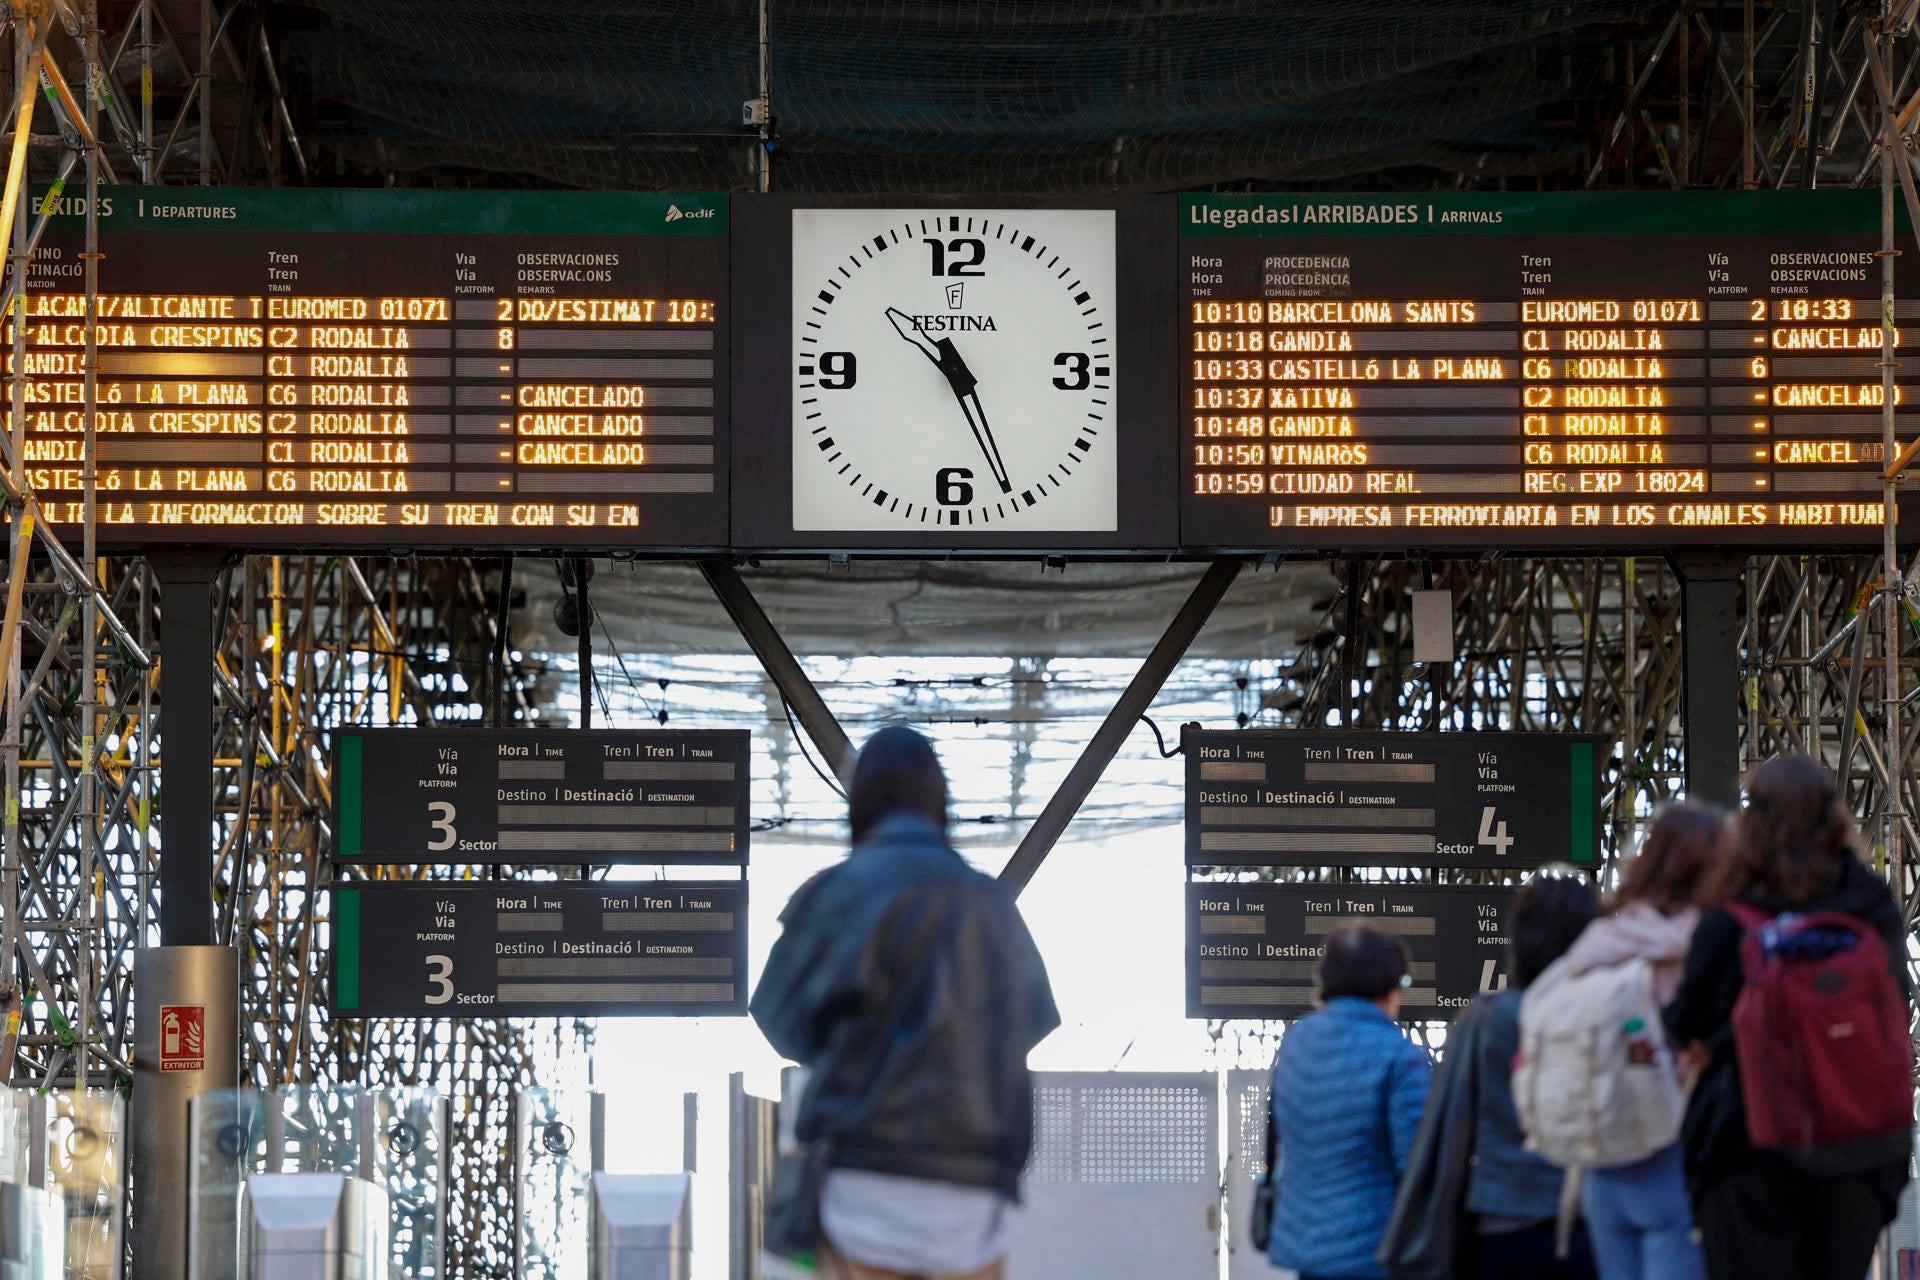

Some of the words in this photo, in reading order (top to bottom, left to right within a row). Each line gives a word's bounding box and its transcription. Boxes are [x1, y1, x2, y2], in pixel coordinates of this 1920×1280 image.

[32, 197, 113, 216] EXIDS
[153, 206, 236, 218] DEPARTURES
[685, 208, 715, 219] adif
[1192, 205, 1289, 228] Llegadas
[1303, 205, 1417, 223] ARRIBADES
[1442, 212, 1501, 222] ARRIVALS
[268, 252, 297, 263] Tren
[518, 254, 618, 265] OBSERVACIONES
[923, 239, 985, 276] 12
[1192, 256, 1222, 267] Hora
[1266, 257, 1349, 268] PROCEDENCIA
[1522, 256, 1551, 266] Tren
[1709, 253, 1728, 265] Vía
[1771, 253, 1874, 264] OBSERVACIONES
[6, 263, 82, 276] DSTINACIÓ
[268, 268, 297, 279] Tren
[456, 269, 475, 280] Via
[1771, 270, 1865, 281] OBSERVACIONS
[1192, 272, 1222, 283] Hora
[1522, 272, 1551, 282] Tren
[270, 299, 366, 319] EUROMED
[381, 300, 448, 320] 01071
[499, 300, 512, 320] 2
[519, 301, 655, 321] DO/ESTIMAT
[1194, 303, 1261, 323] 10:10
[1269, 303, 1392, 322] BARCELONA
[1406, 303, 1474, 322] SANTS
[1523, 302, 1619, 321] EUROMED
[1634, 302, 1700, 321] 01071
[1752, 301, 1764, 320] 2
[912, 315, 997, 331] FESTINA
[150, 327, 262, 347] CRESPINS
[270, 328, 297, 347] C2
[312, 328, 408, 348] RODALIA
[499, 329, 512, 349] 8
[1195, 332, 1262, 351] 10:18
[1270, 332, 1351, 351] GANDIA
[1524, 331, 1549, 350] C1
[1566, 330, 1661, 350] RODALIA
[269, 356, 295, 376] C1
[311, 357, 408, 377] RODALIA
[819, 352, 856, 389] 9
[1053, 353, 1090, 390] 3
[1195, 360, 1262, 379] 10:33
[1393, 360, 1420, 379] LA
[1434, 360, 1502, 379] PLANA
[1523, 359, 1551, 378] C6
[1752, 358, 1765, 377] 6
[136, 384, 164, 404] LA
[179, 384, 248, 404] PLANA
[270, 385, 296, 404] C6
[312, 385, 408, 405] RODALIA
[520, 386, 643, 407] CANCELADO
[1193, 388, 1263, 408] 10:37
[1524, 388, 1552, 407] C2
[1566, 387, 1662, 407] RODALIA
[149, 413, 261, 433] CRESPINS
[269, 414, 296, 433] C2
[311, 414, 408, 434] RODALIA
[519, 415, 643, 435] CANCELADO
[1195, 417, 1263, 436] 10:48
[1270, 416, 1352, 436] GANDIA
[1524, 416, 1549, 435] C1
[1565, 416, 1662, 435] RODALIA
[269, 442, 295, 462] C1
[311, 443, 408, 463] RODALIA
[519, 444, 643, 464] CANCELADO
[1196, 445, 1263, 464] 10:50
[1525, 444, 1552, 464] C6
[1567, 444, 1662, 463] RODALIA
[135, 470, 162, 490] LA
[177, 471, 247, 490] PLANA
[268, 471, 296, 491] C6
[310, 471, 407, 491] RODALIA
[936, 468, 973, 505] 6
[1195, 474, 1263, 493] 10:59
[1271, 474, 1353, 493] CIUDAD
[1367, 474, 1421, 493] REAL
[1636, 472, 1704, 492] 18024
[106, 504, 134, 523] LA
[148, 504, 303, 524] INFORMACION
[317, 504, 387, 524] SOBRE
[400, 505, 429, 524] SU
[445, 505, 498, 525] TREN
[511, 505, 554, 525] CON
[567, 506, 595, 525] SU
[608, 506, 638, 525] EM
[1296, 507, 1391, 526] EMPRESA
[1406, 506, 1556, 525] FERROVIARIA
[1572, 506, 1599, 525] EN
[1613, 506, 1655, 525] LOS
[1669, 505, 1766, 525] CANALES
[439, 748, 457, 760] Vía
[499, 745, 528, 755] Hora
[604, 745, 630, 756] Tren
[645, 746, 673, 756] Tren
[1201, 747, 1229, 757] Hora
[1304, 748, 1330, 759] Tren
[1346, 749, 1373, 759] Tren
[1478, 753, 1497, 765] Vía
[438, 763, 457, 774] Via
[1478, 767, 1497, 778] Via
[498, 789, 546, 800] Destino
[565, 789, 633, 801] Destinació
[1200, 792, 1247, 803] Destino
[1266, 792, 1334, 803] Destinació
[428, 802, 456, 850] 3
[1478, 807, 1514, 855] 4
[459, 839, 498, 851] Sector
[1436, 843, 1474, 855] Sector
[437, 901, 455, 912] Vía
[497, 898, 526, 908] Hora
[602, 898, 628, 908] Tren
[644, 898, 671, 908] Tren
[1200, 900, 1229, 910] Hora
[1305, 901, 1331, 911] Tren
[1346, 901, 1374, 912] Tren
[1478, 905, 1496, 916] Vía
[436, 916, 455, 927] Via
[1478, 920, 1497, 931] Via
[496, 943, 544, 953] Destino
[563, 941, 631, 953] Destinació
[1201, 945, 1248, 956] Destino
[425, 955, 453, 1004] 3
[457, 993, 496, 1005] Sector
